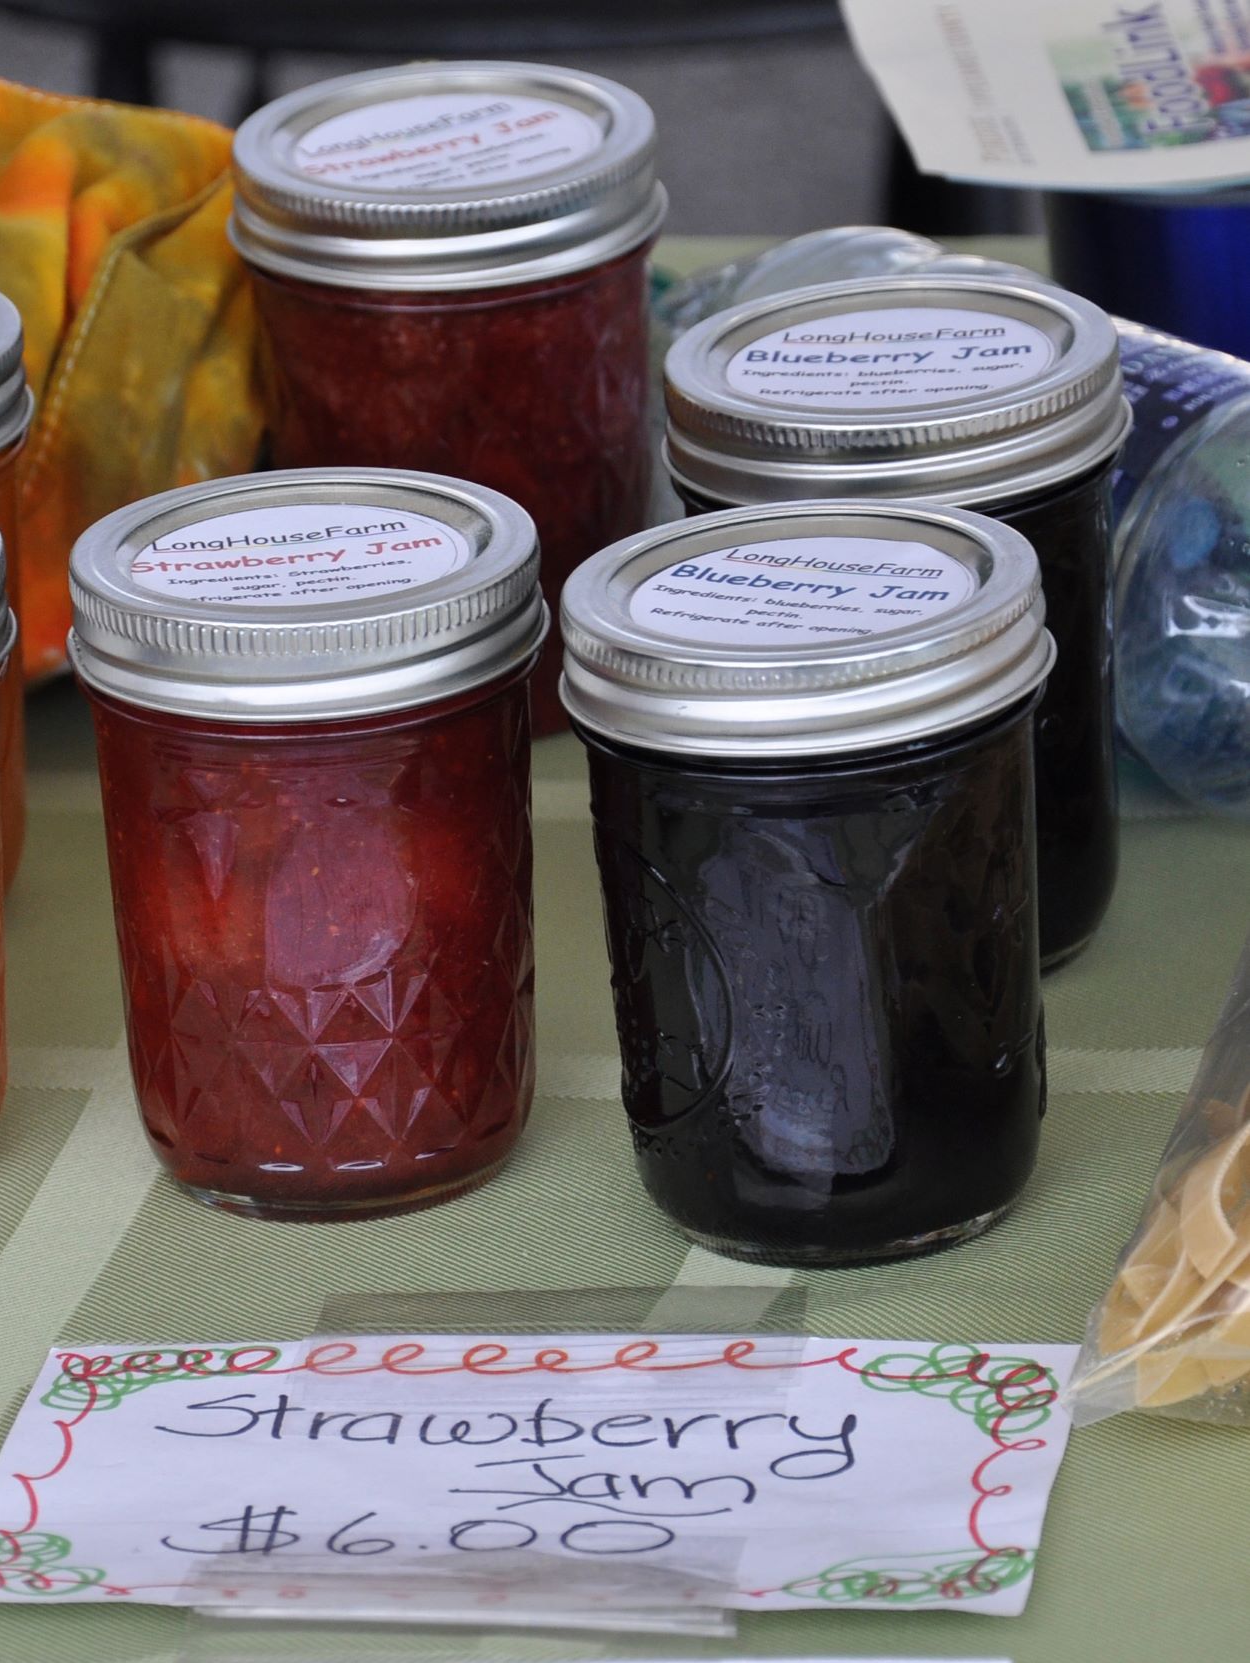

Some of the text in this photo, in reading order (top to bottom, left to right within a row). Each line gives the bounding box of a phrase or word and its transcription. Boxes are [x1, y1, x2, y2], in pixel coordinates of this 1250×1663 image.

[301, 102, 512, 157] LongHouseFarm
[305, 133, 481, 175] Strawberry
[493, 110, 559, 134] Jam
[783, 326, 1006, 344] LongHouseFarm
[746, 345, 1031, 364] Blueberry Jam
[759, 387, 862, 396] Refrigerate
[152, 518, 408, 553] LongHouseFarm
[131, 535, 442, 573] Strawberry Jam
[723, 548, 943, 579] LongHouseFarm
[167, 573, 278, 585] Ingredients:
[190, 592, 281, 602] frigerate
[290, 587, 338, 595] after
[653, 584, 758, 603] Ingredients:
[671, 563, 949, 601] Blueberry Jam
[650, 607, 749, 626] Refrigerate
[757, 620, 803, 630] after
[156, 1392, 855, 1481] Strawberry
[449, 1453, 755, 1517] Jam
[161, 1506, 677, 1559] $6.00
